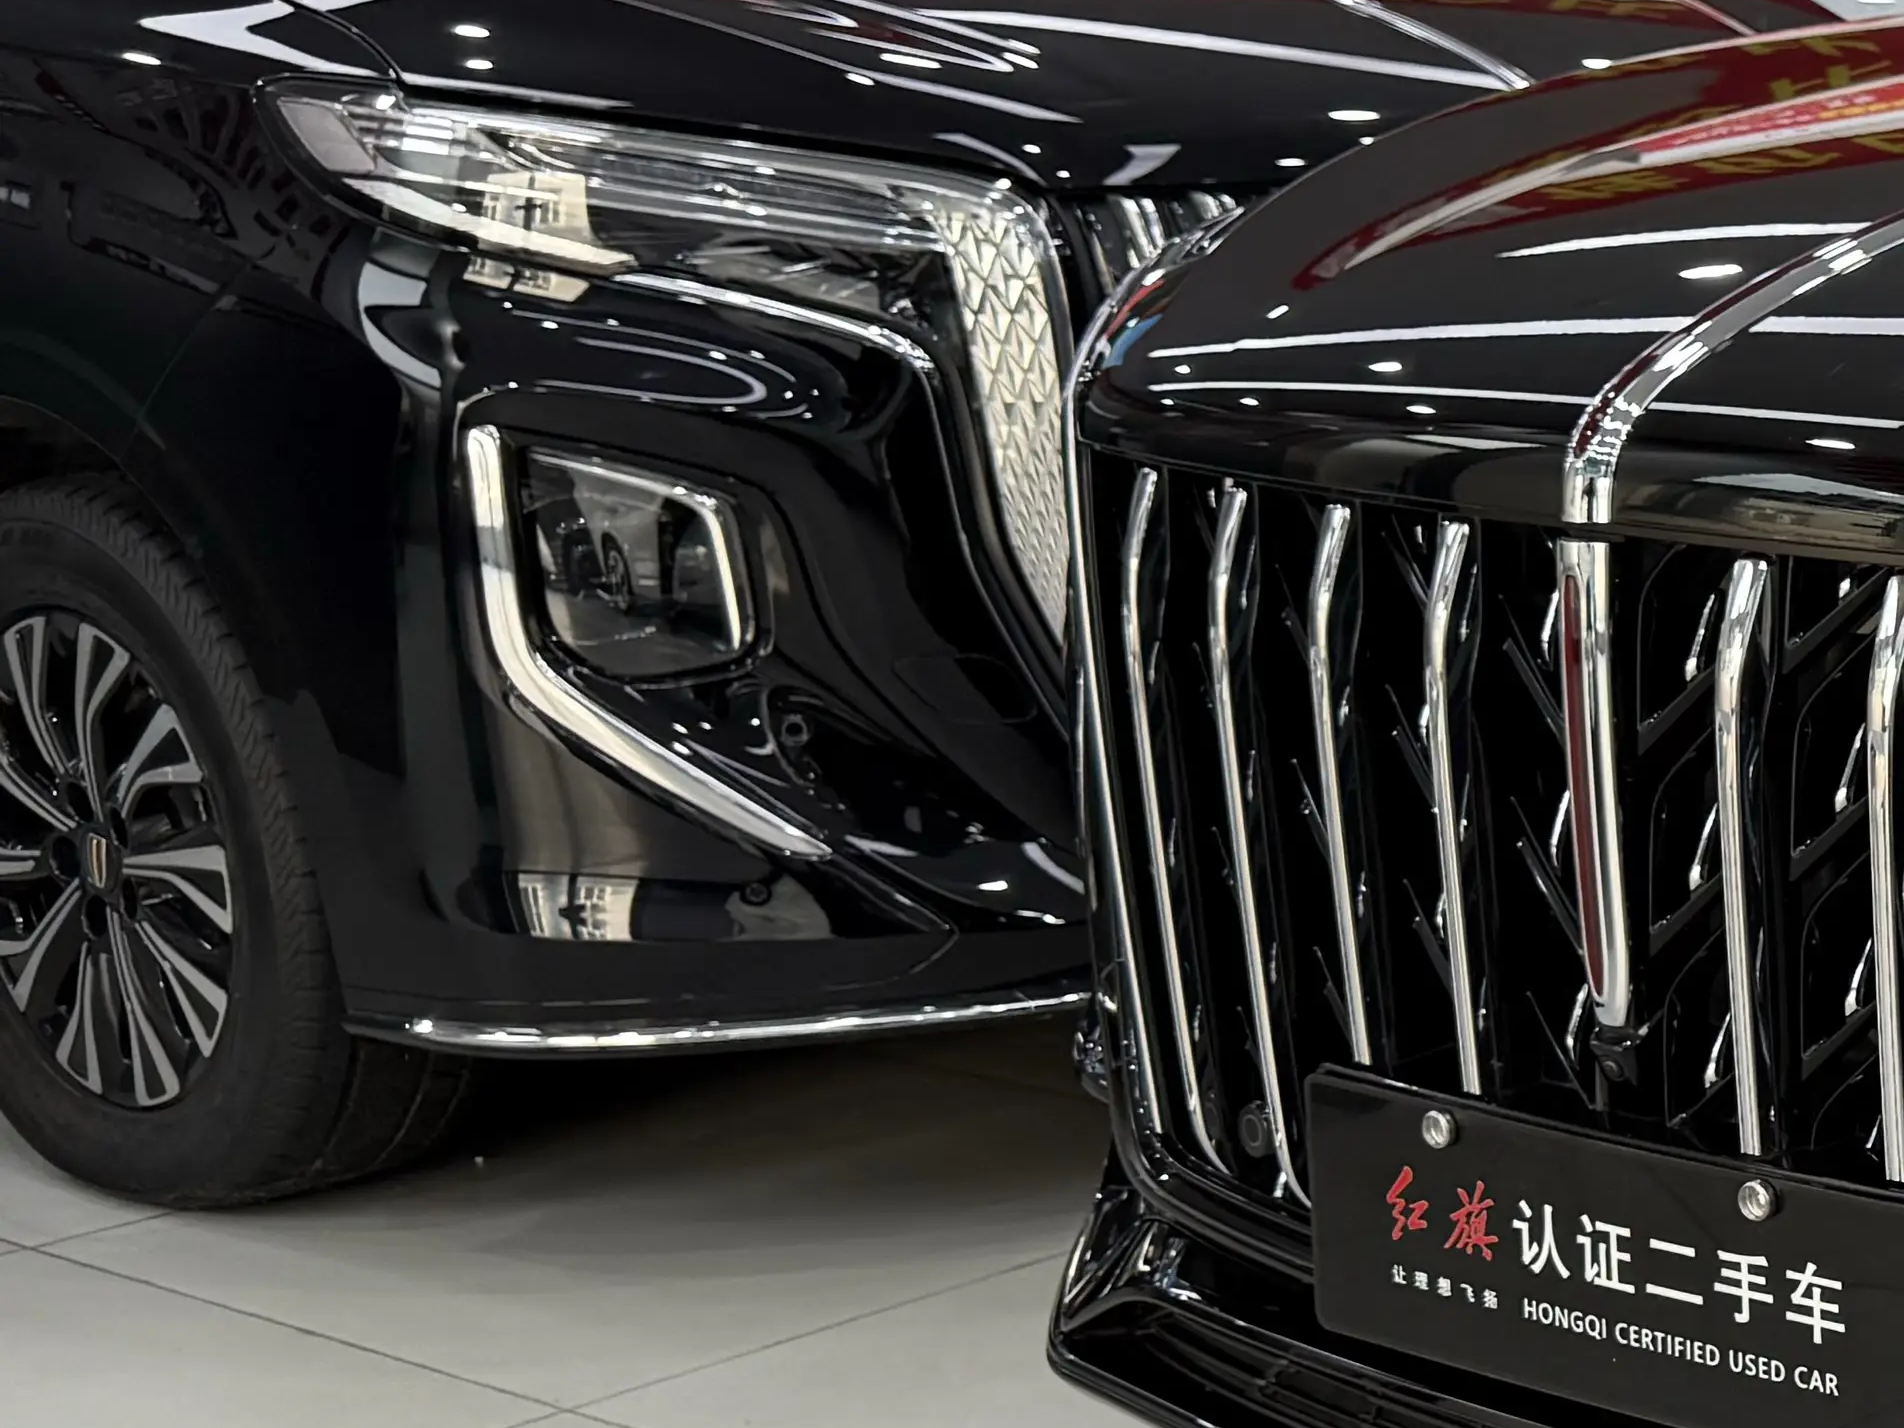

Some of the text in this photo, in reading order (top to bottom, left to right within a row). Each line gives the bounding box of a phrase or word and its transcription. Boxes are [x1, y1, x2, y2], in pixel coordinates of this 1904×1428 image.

[1522, 1297, 1839, 1397] HONGQI CERTIFIED USED CAR
